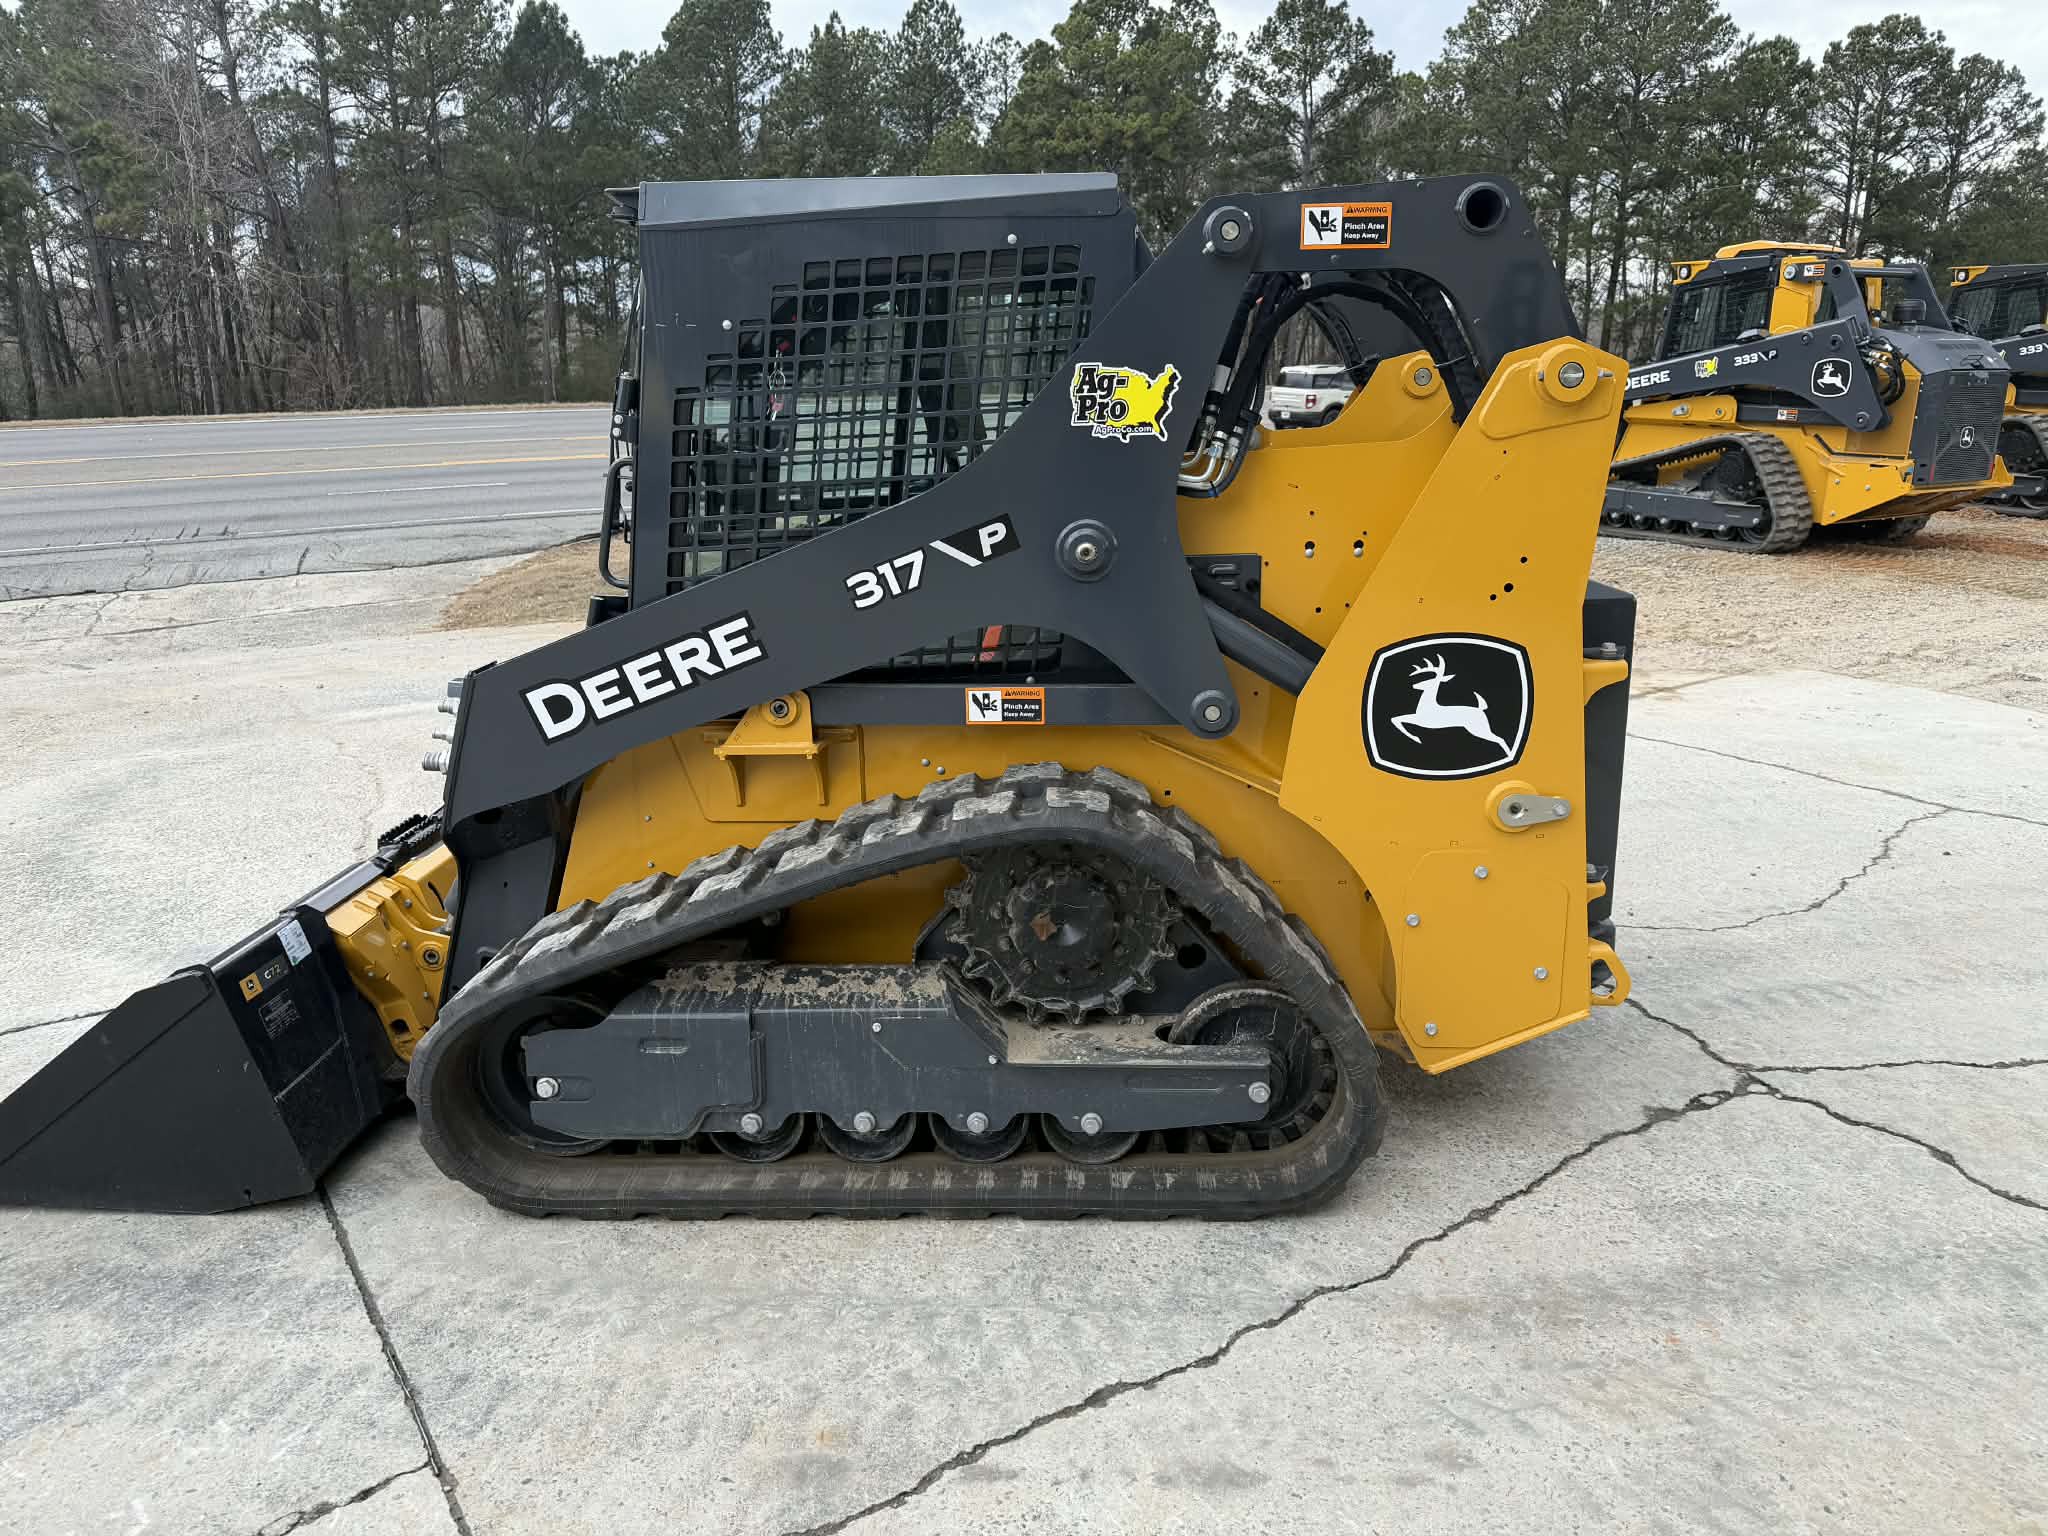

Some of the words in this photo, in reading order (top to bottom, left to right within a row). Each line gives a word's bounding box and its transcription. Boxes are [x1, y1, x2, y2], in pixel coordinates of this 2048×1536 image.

[1353, 206, 1388, 214] WARNING
[1344, 222, 1366, 230] Pinch
[1367, 222, 1385, 230] Area
[1361, 232, 1379, 240] Away
[2018, 343, 2043, 356] 333
[1733, 352, 1759, 366] 333
[1075, 366, 1128, 399] Ag-
[1075, 394, 1128, 421] Pro
[1095, 424, 1152, 434] AgProCo.com
[845, 549, 924, 609] 317
[978, 522, 1007, 557] P
[525, 616, 762, 740] DEERE
